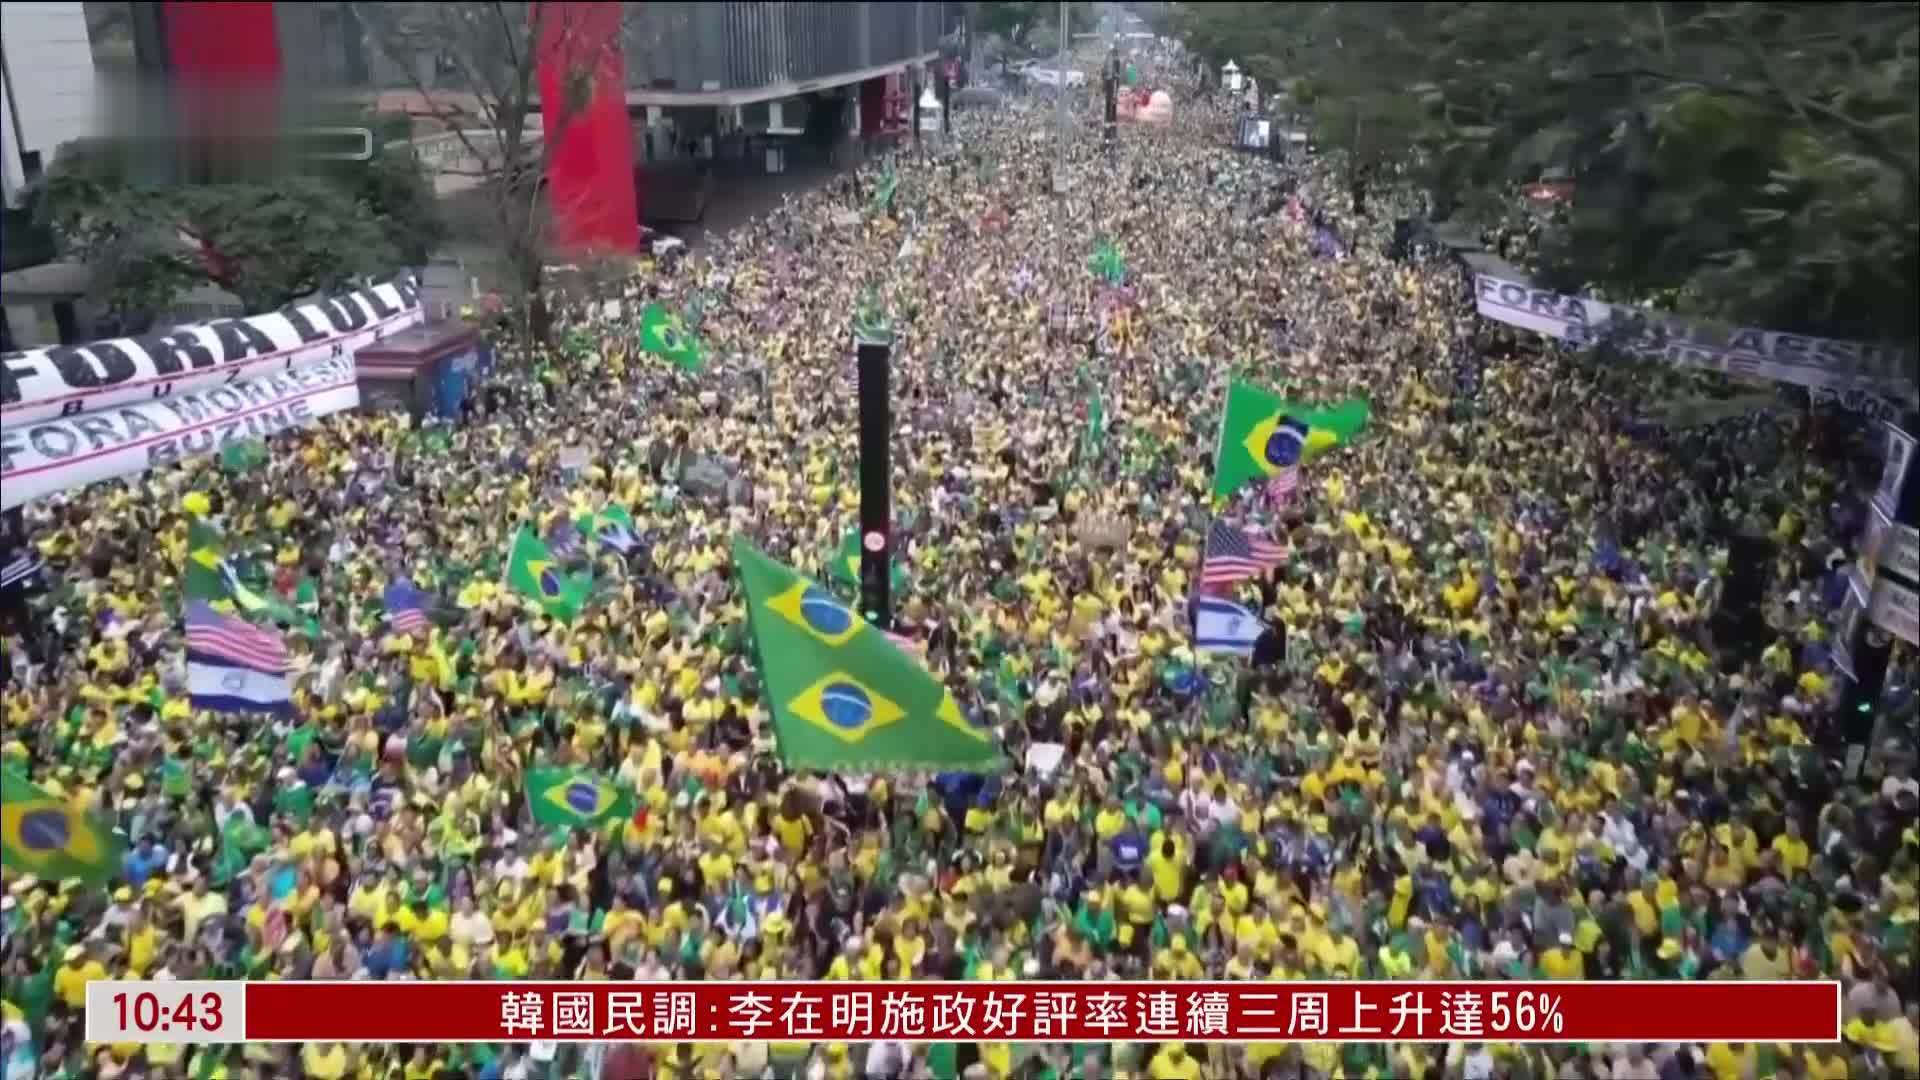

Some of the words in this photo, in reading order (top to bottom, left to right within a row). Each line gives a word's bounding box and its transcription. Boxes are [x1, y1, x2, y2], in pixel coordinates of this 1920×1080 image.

[1479, 279, 1586, 322] FORA
[1, 317, 277, 402] FORA
[2, 409, 162, 470] FORA
[147, 399, 312, 464] BUZINE
